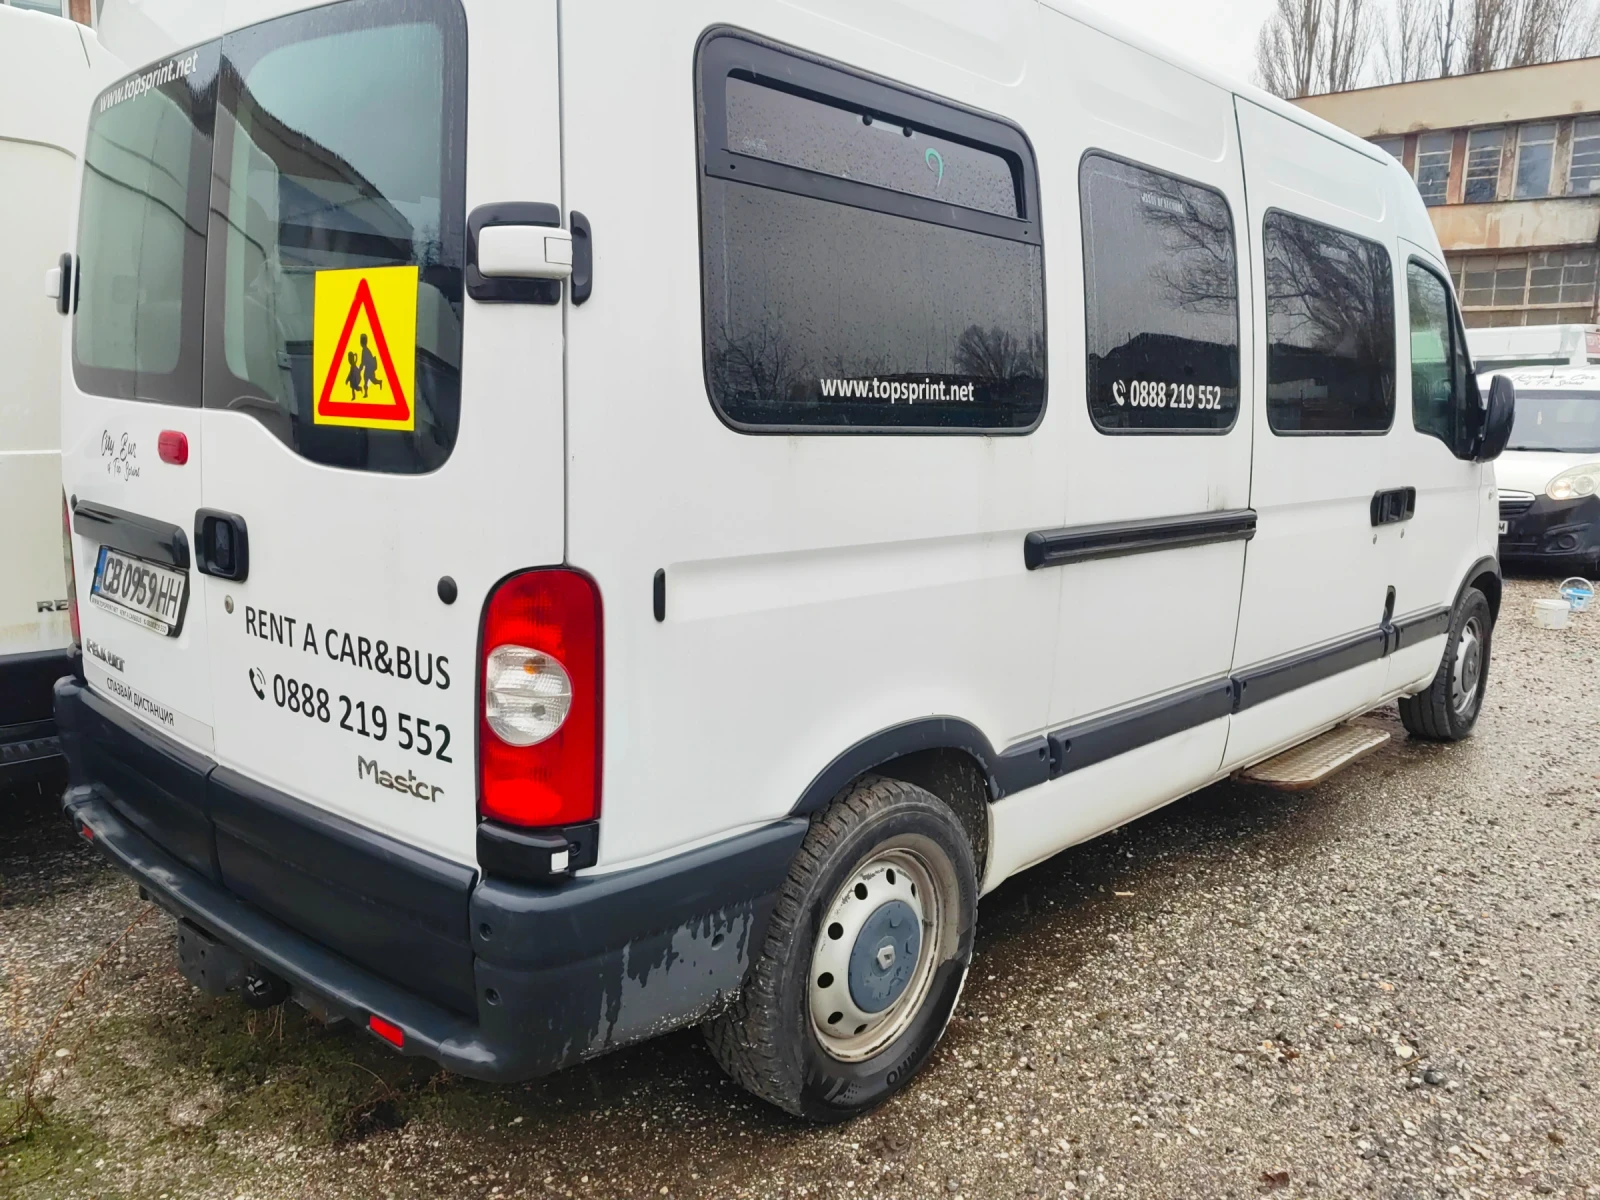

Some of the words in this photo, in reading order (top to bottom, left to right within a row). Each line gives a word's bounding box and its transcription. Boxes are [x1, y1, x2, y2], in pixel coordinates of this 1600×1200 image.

[100, 51, 198, 113] www.topsprint.net
[820, 378, 975, 405] www.topsprint.net
[1130, 380, 1167, 408] 0888
[1169, 383, 1195, 409] 219
[1198, 386, 1221, 410] 552
[245, 605, 297, 648] RENT
[302, 622, 319, 656] A
[324, 628, 451, 690] CAR&BUS
[106, 676, 133, 703] СПАЗВАЙ
[133, 696, 175, 727] ДИСТАНЦИЯ
[273, 673, 331, 724] 0888
[338, 694, 387, 742] 219
[397, 712, 453, 764] 552
[357, 754, 445, 803] Master
